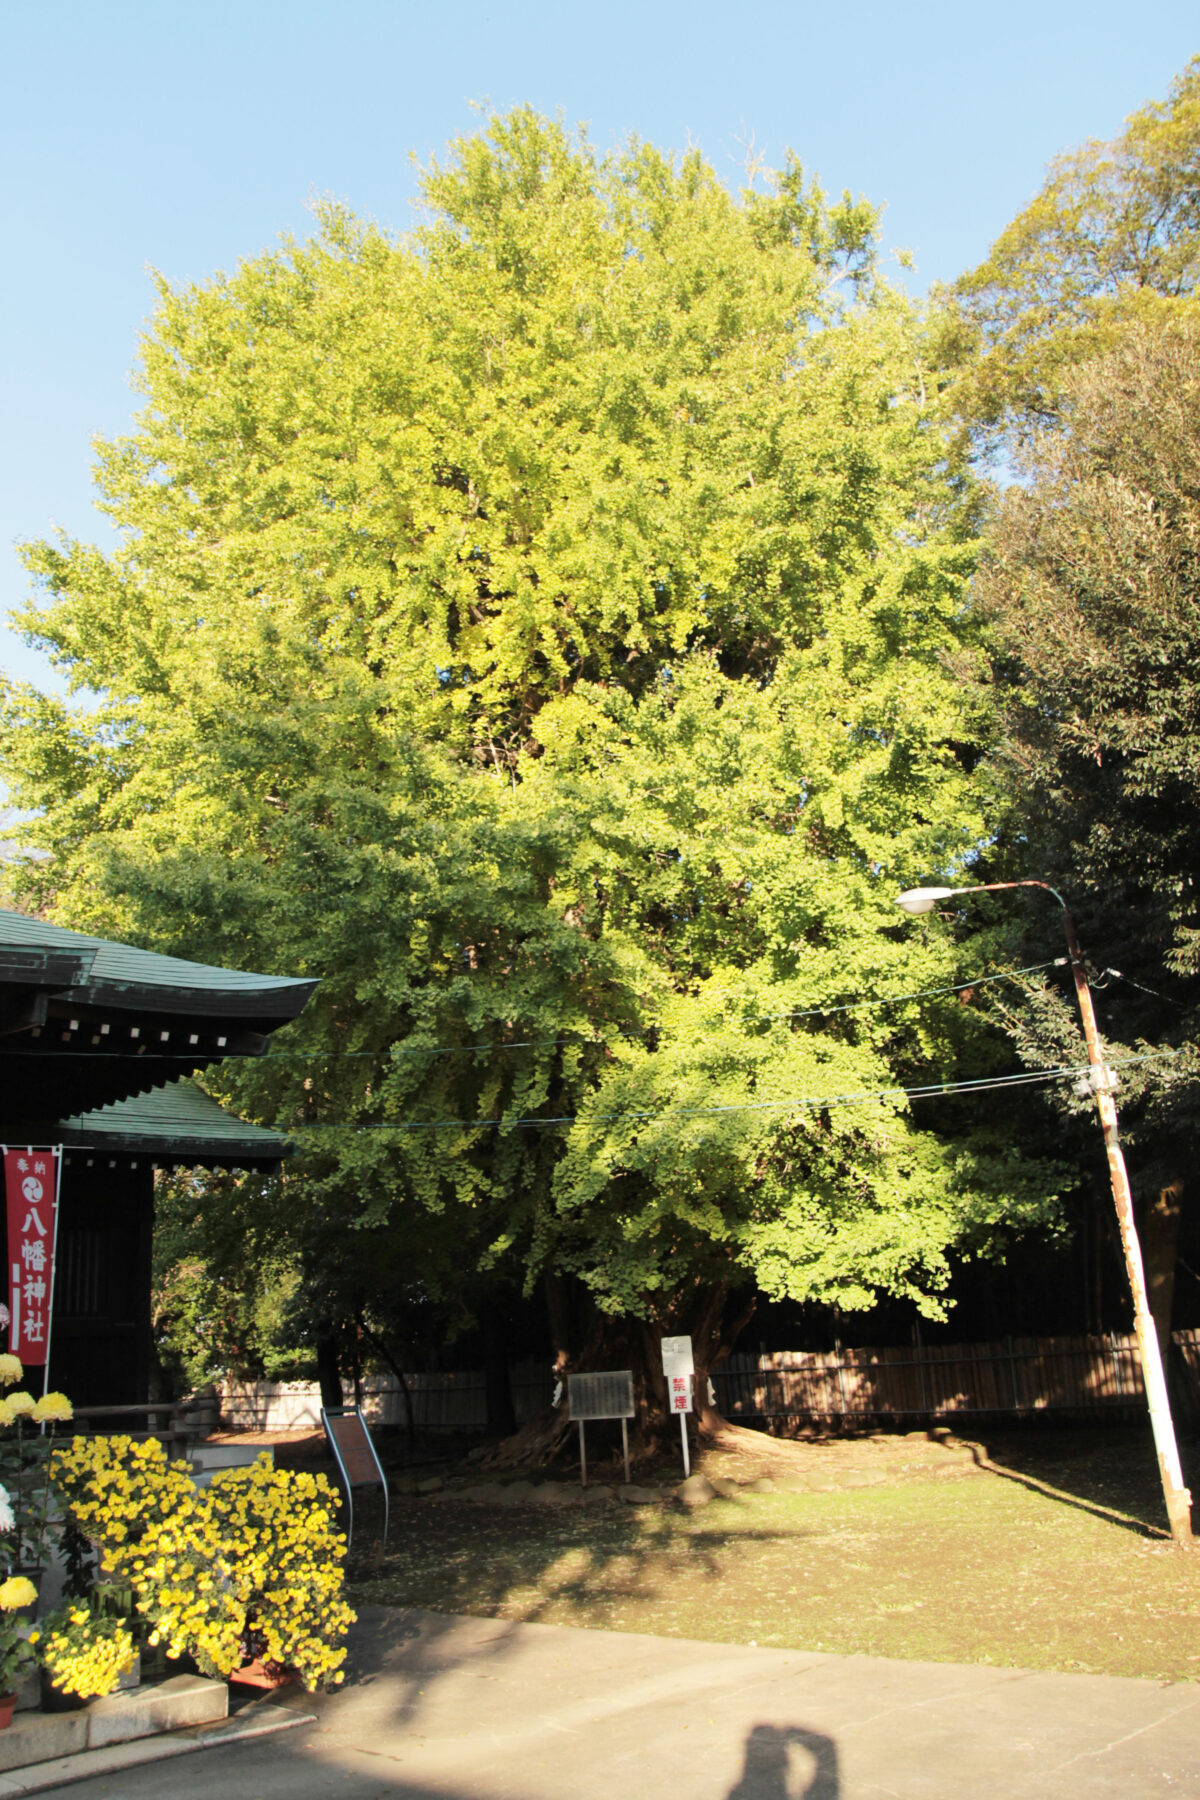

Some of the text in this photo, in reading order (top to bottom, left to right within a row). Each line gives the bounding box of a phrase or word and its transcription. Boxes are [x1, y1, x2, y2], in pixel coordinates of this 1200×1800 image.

[17, 1158, 46, 1175] 奉納
[21, 1207, 47, 1342] 八幡神社
[672, 1377, 688, 1410] 禁煙
